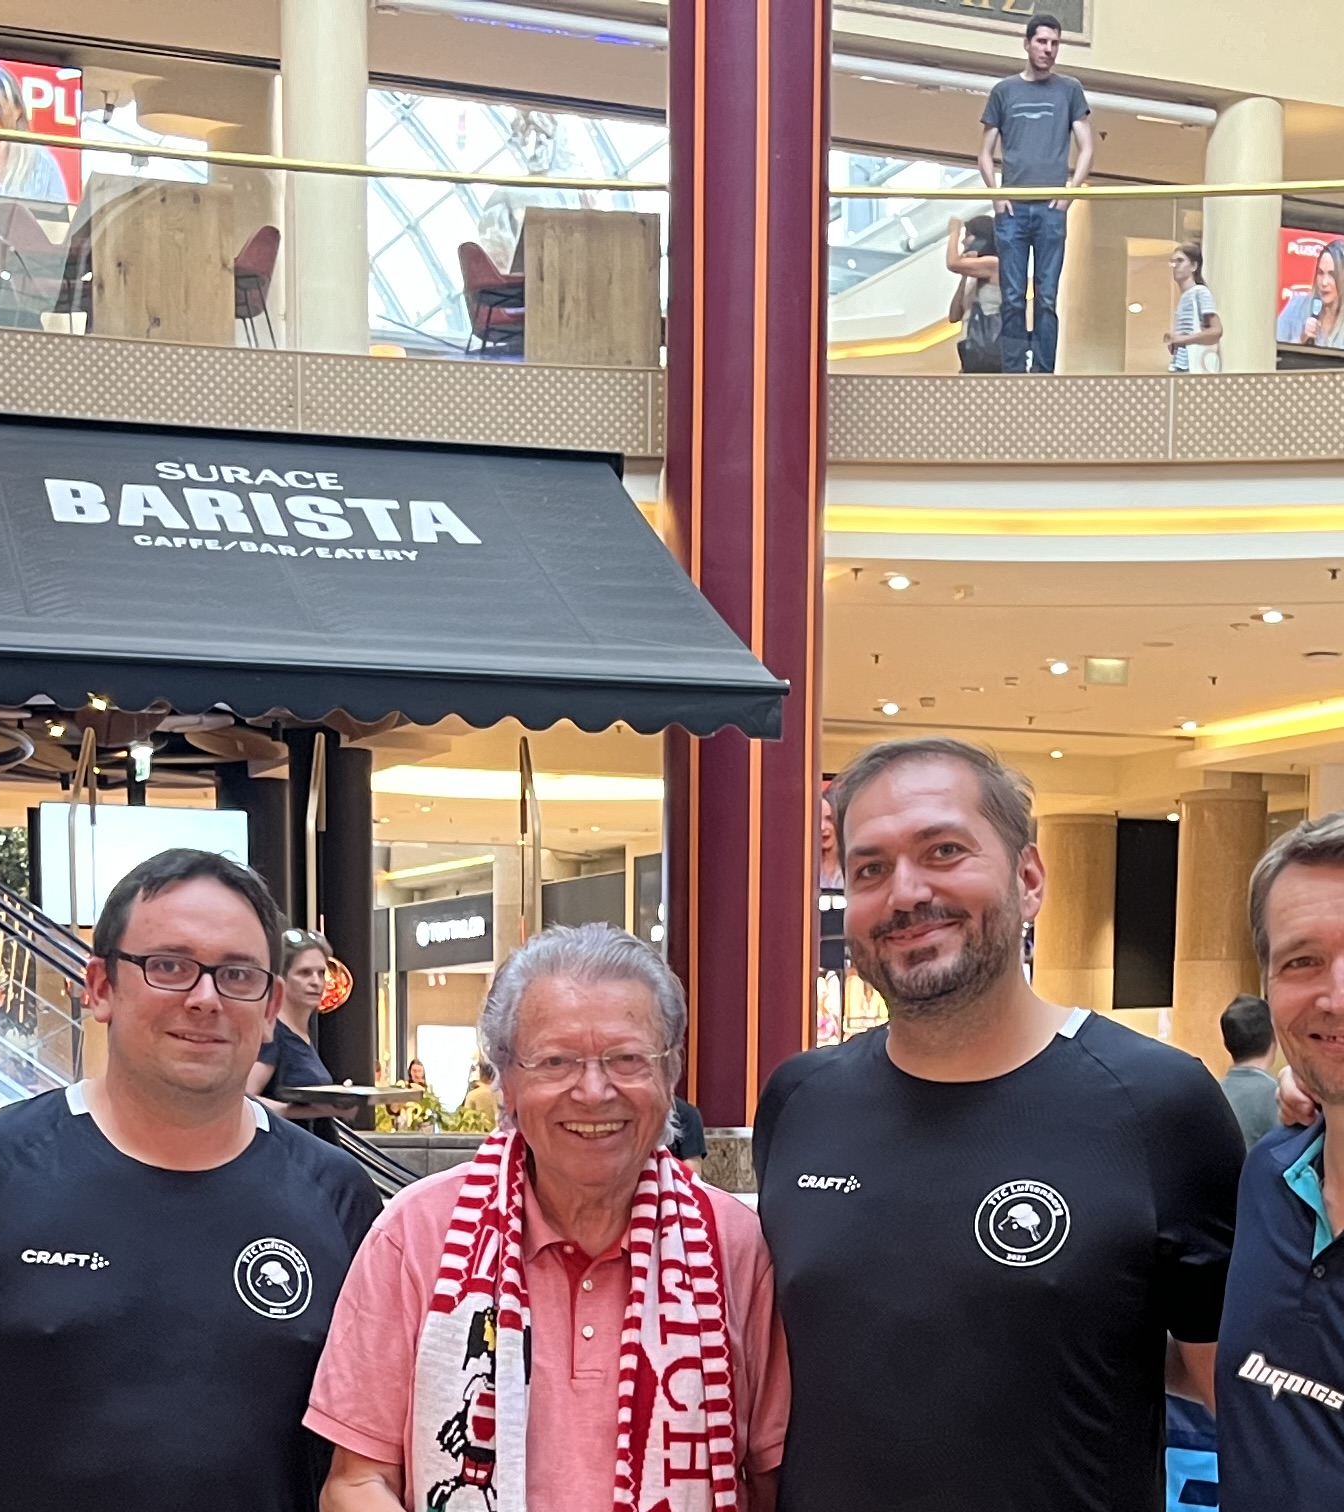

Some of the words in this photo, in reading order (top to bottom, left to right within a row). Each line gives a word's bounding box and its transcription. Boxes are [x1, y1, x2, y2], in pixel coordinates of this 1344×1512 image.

[155, 461, 344, 491] SURACE
[44, 478, 482, 545] BARISTA
[133, 533, 418, 562] CAFFE/BAR/EATERY
[797, 1174, 846, 1192] CRAFT
[988, 1187, 1009, 1206] TTC
[21, 1249, 90, 1267] CRAFT
